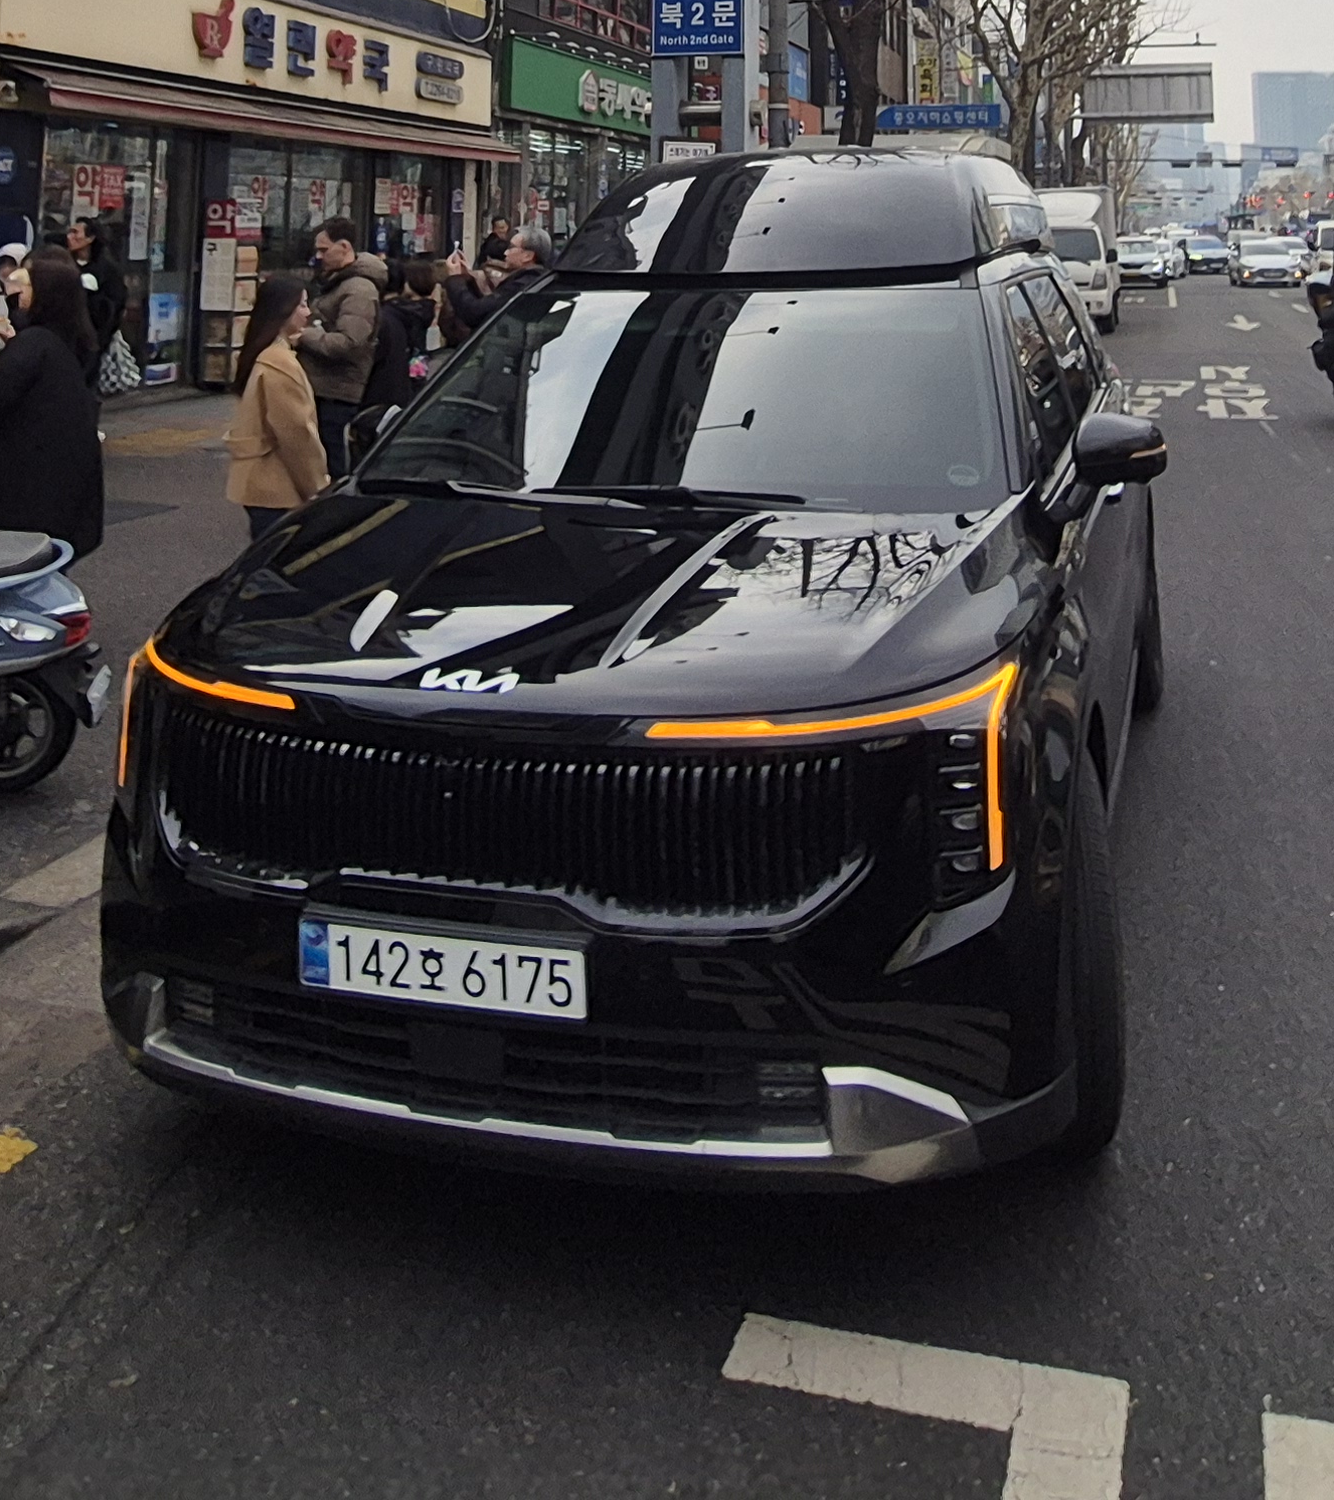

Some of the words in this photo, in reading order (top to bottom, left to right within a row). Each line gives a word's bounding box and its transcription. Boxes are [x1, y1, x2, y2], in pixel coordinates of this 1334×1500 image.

[659, 1, 684, 30] 북
[690, 2, 705, 26] 2
[711, 0, 737, 27] 문
[659, 34, 688, 46] North
[690, 33, 708, 46] 2nd
[709, 33, 734, 45] Gate
[242, 6, 390, 94] 열린약국
[336, 933, 448, 992] 142호
[462, 949, 573, 1008] 6175
